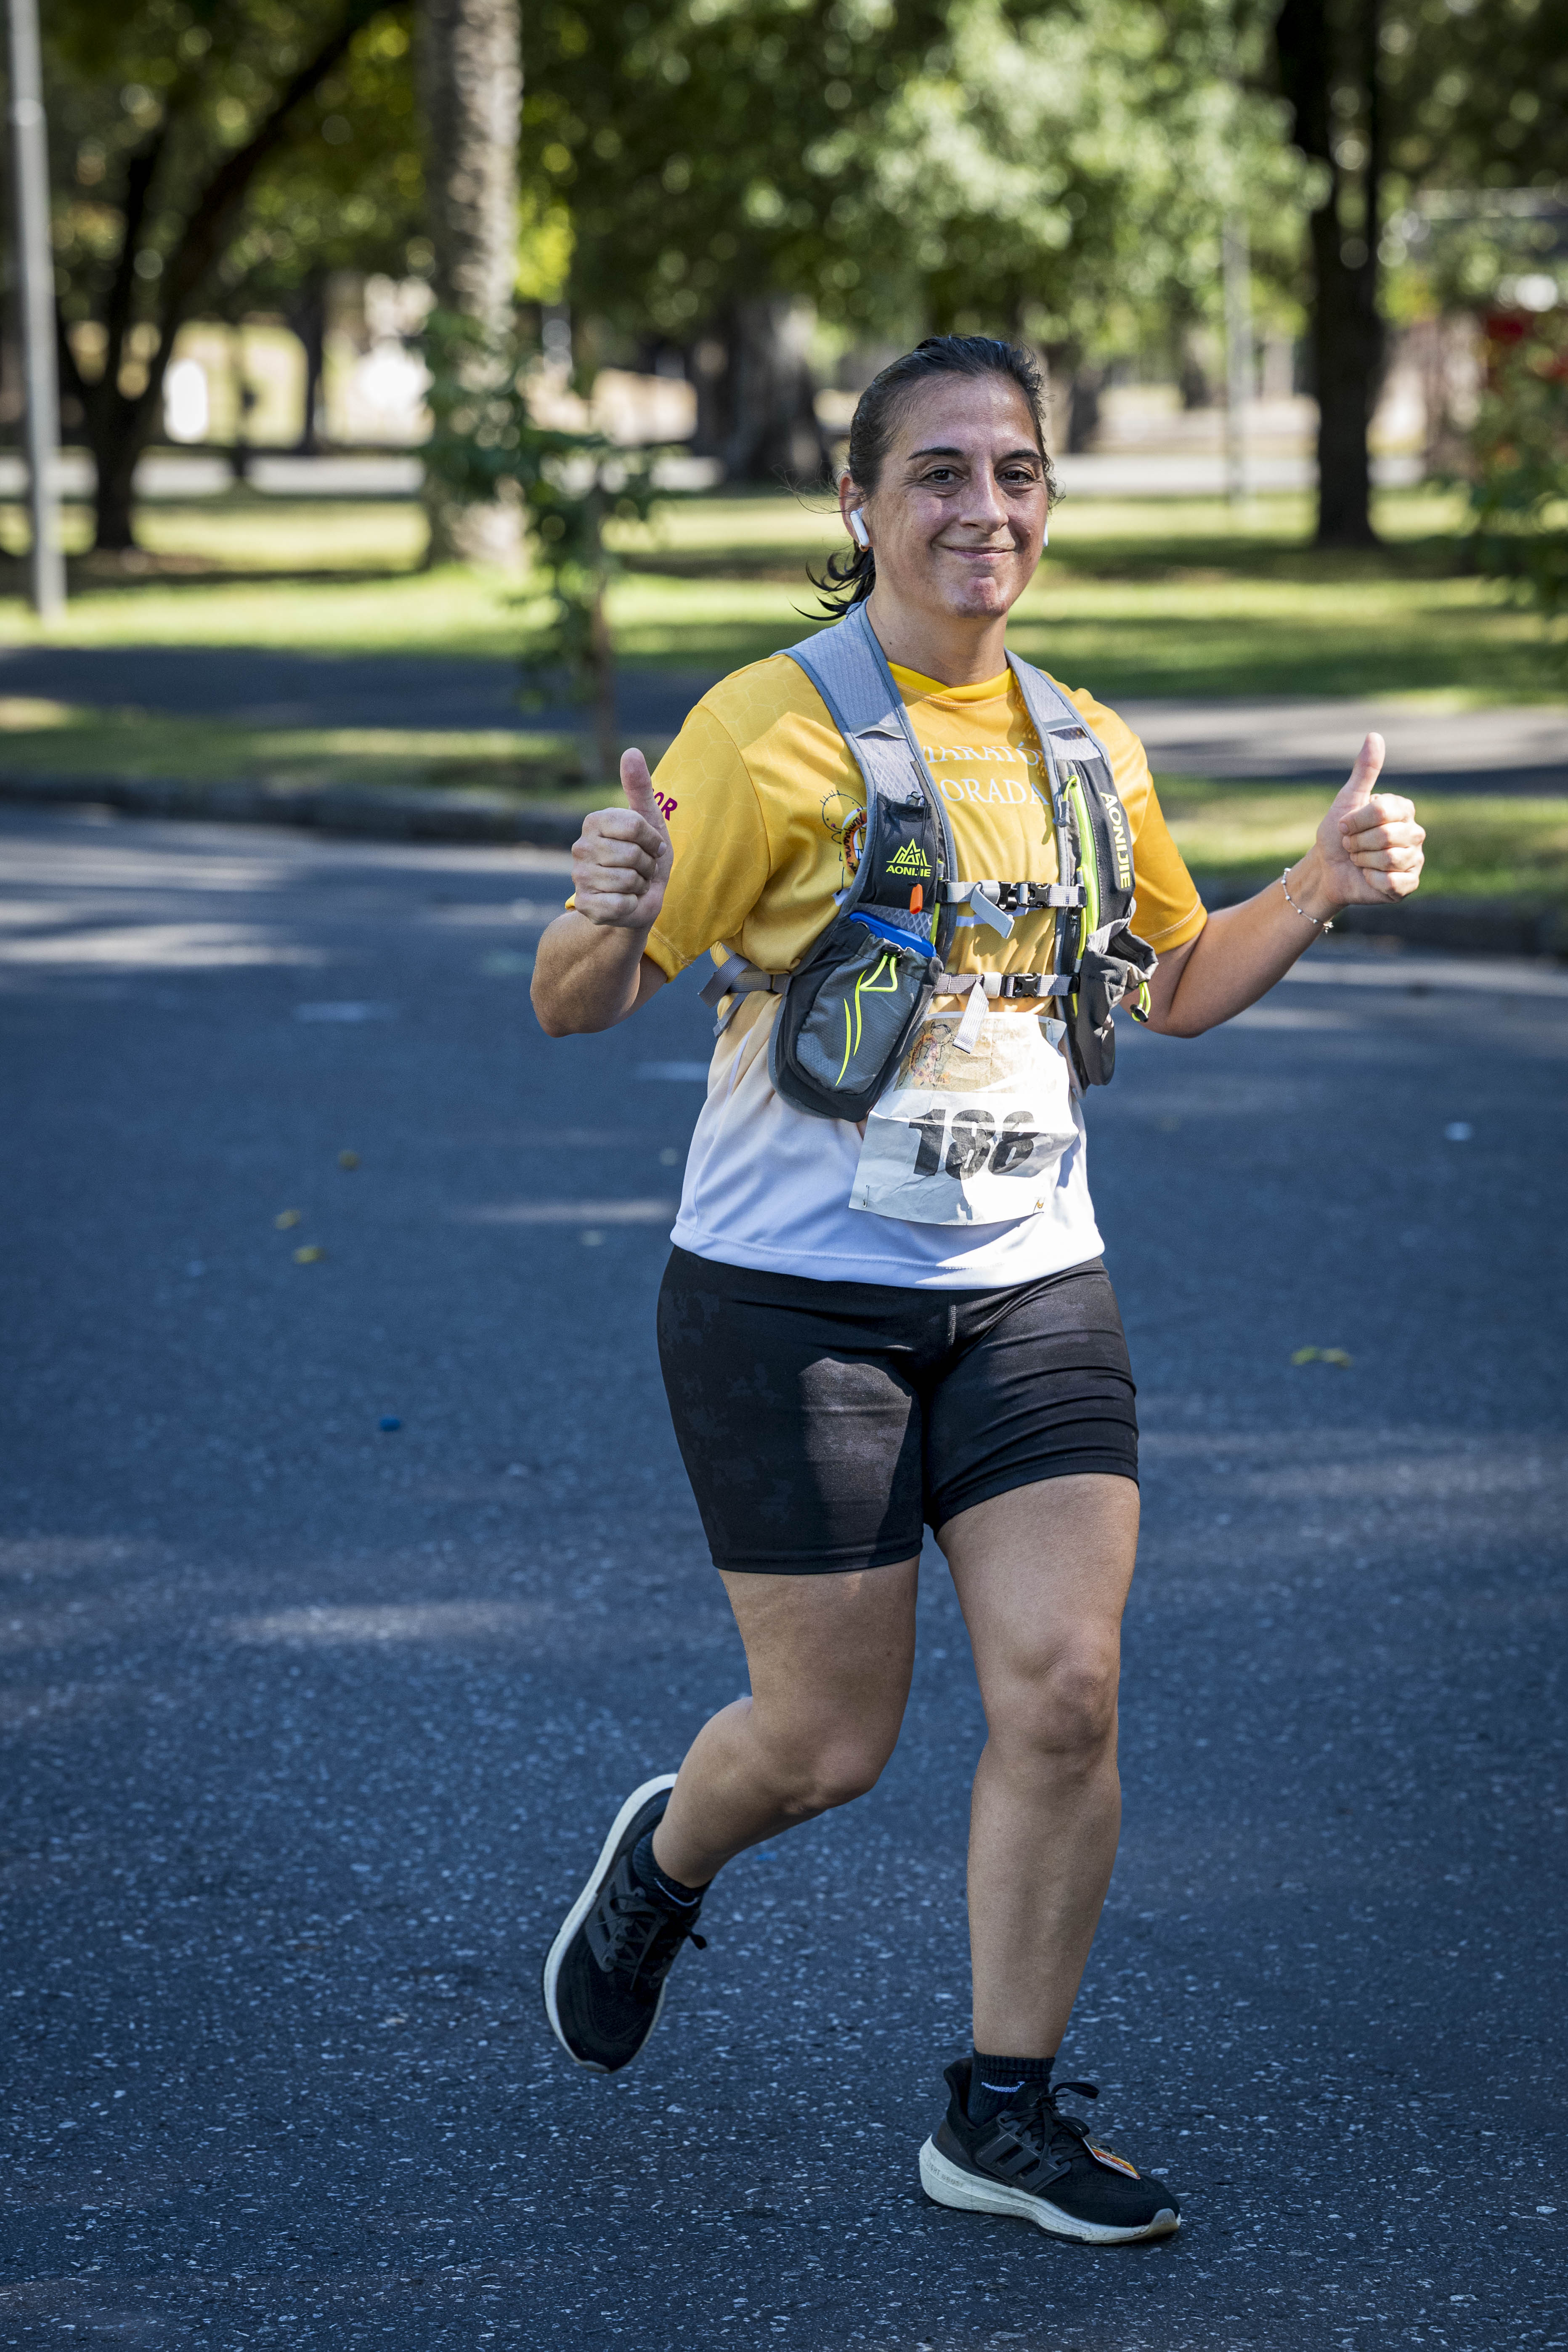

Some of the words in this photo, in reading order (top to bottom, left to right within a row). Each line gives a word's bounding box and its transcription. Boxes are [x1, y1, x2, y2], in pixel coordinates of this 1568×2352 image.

[922, 741, 1044, 766] ARATÓ
[652, 787, 678, 822] OR
[939, 778, 1050, 805] ORADA
[1100, 791, 1131, 889] AONIJIE
